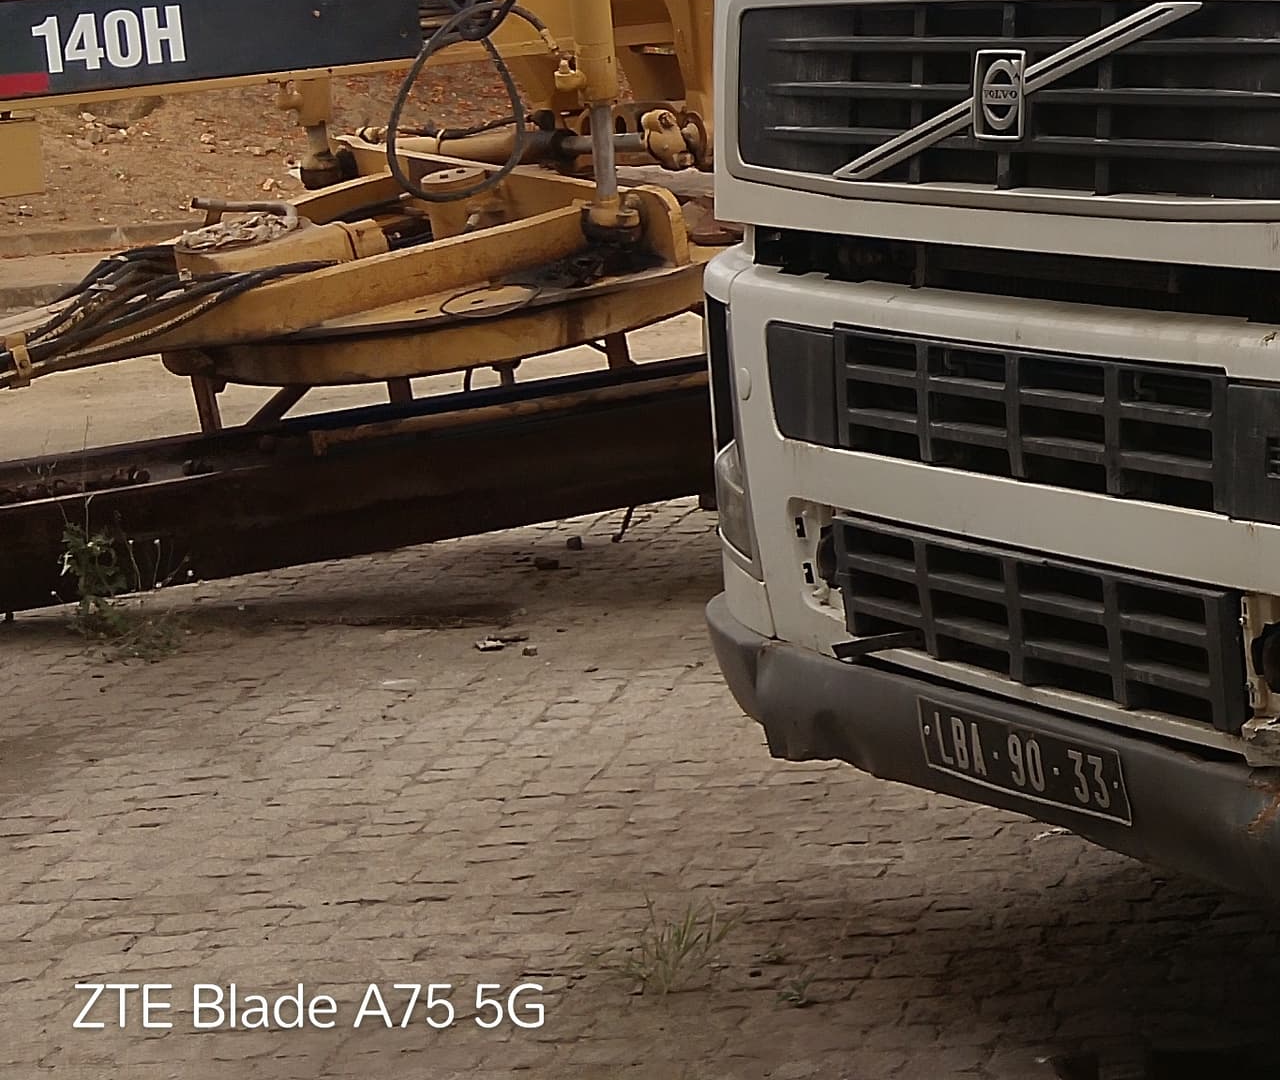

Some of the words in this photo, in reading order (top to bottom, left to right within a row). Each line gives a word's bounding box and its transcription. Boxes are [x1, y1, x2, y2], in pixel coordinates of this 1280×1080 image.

[31, 5, 187, 73] 140H
[983, 89, 1018, 99] VOLVO
[934, 711, 987, 777] LBA
[1007, 733, 1046, 792] 90
[1067, 749, 1111, 809] 33
